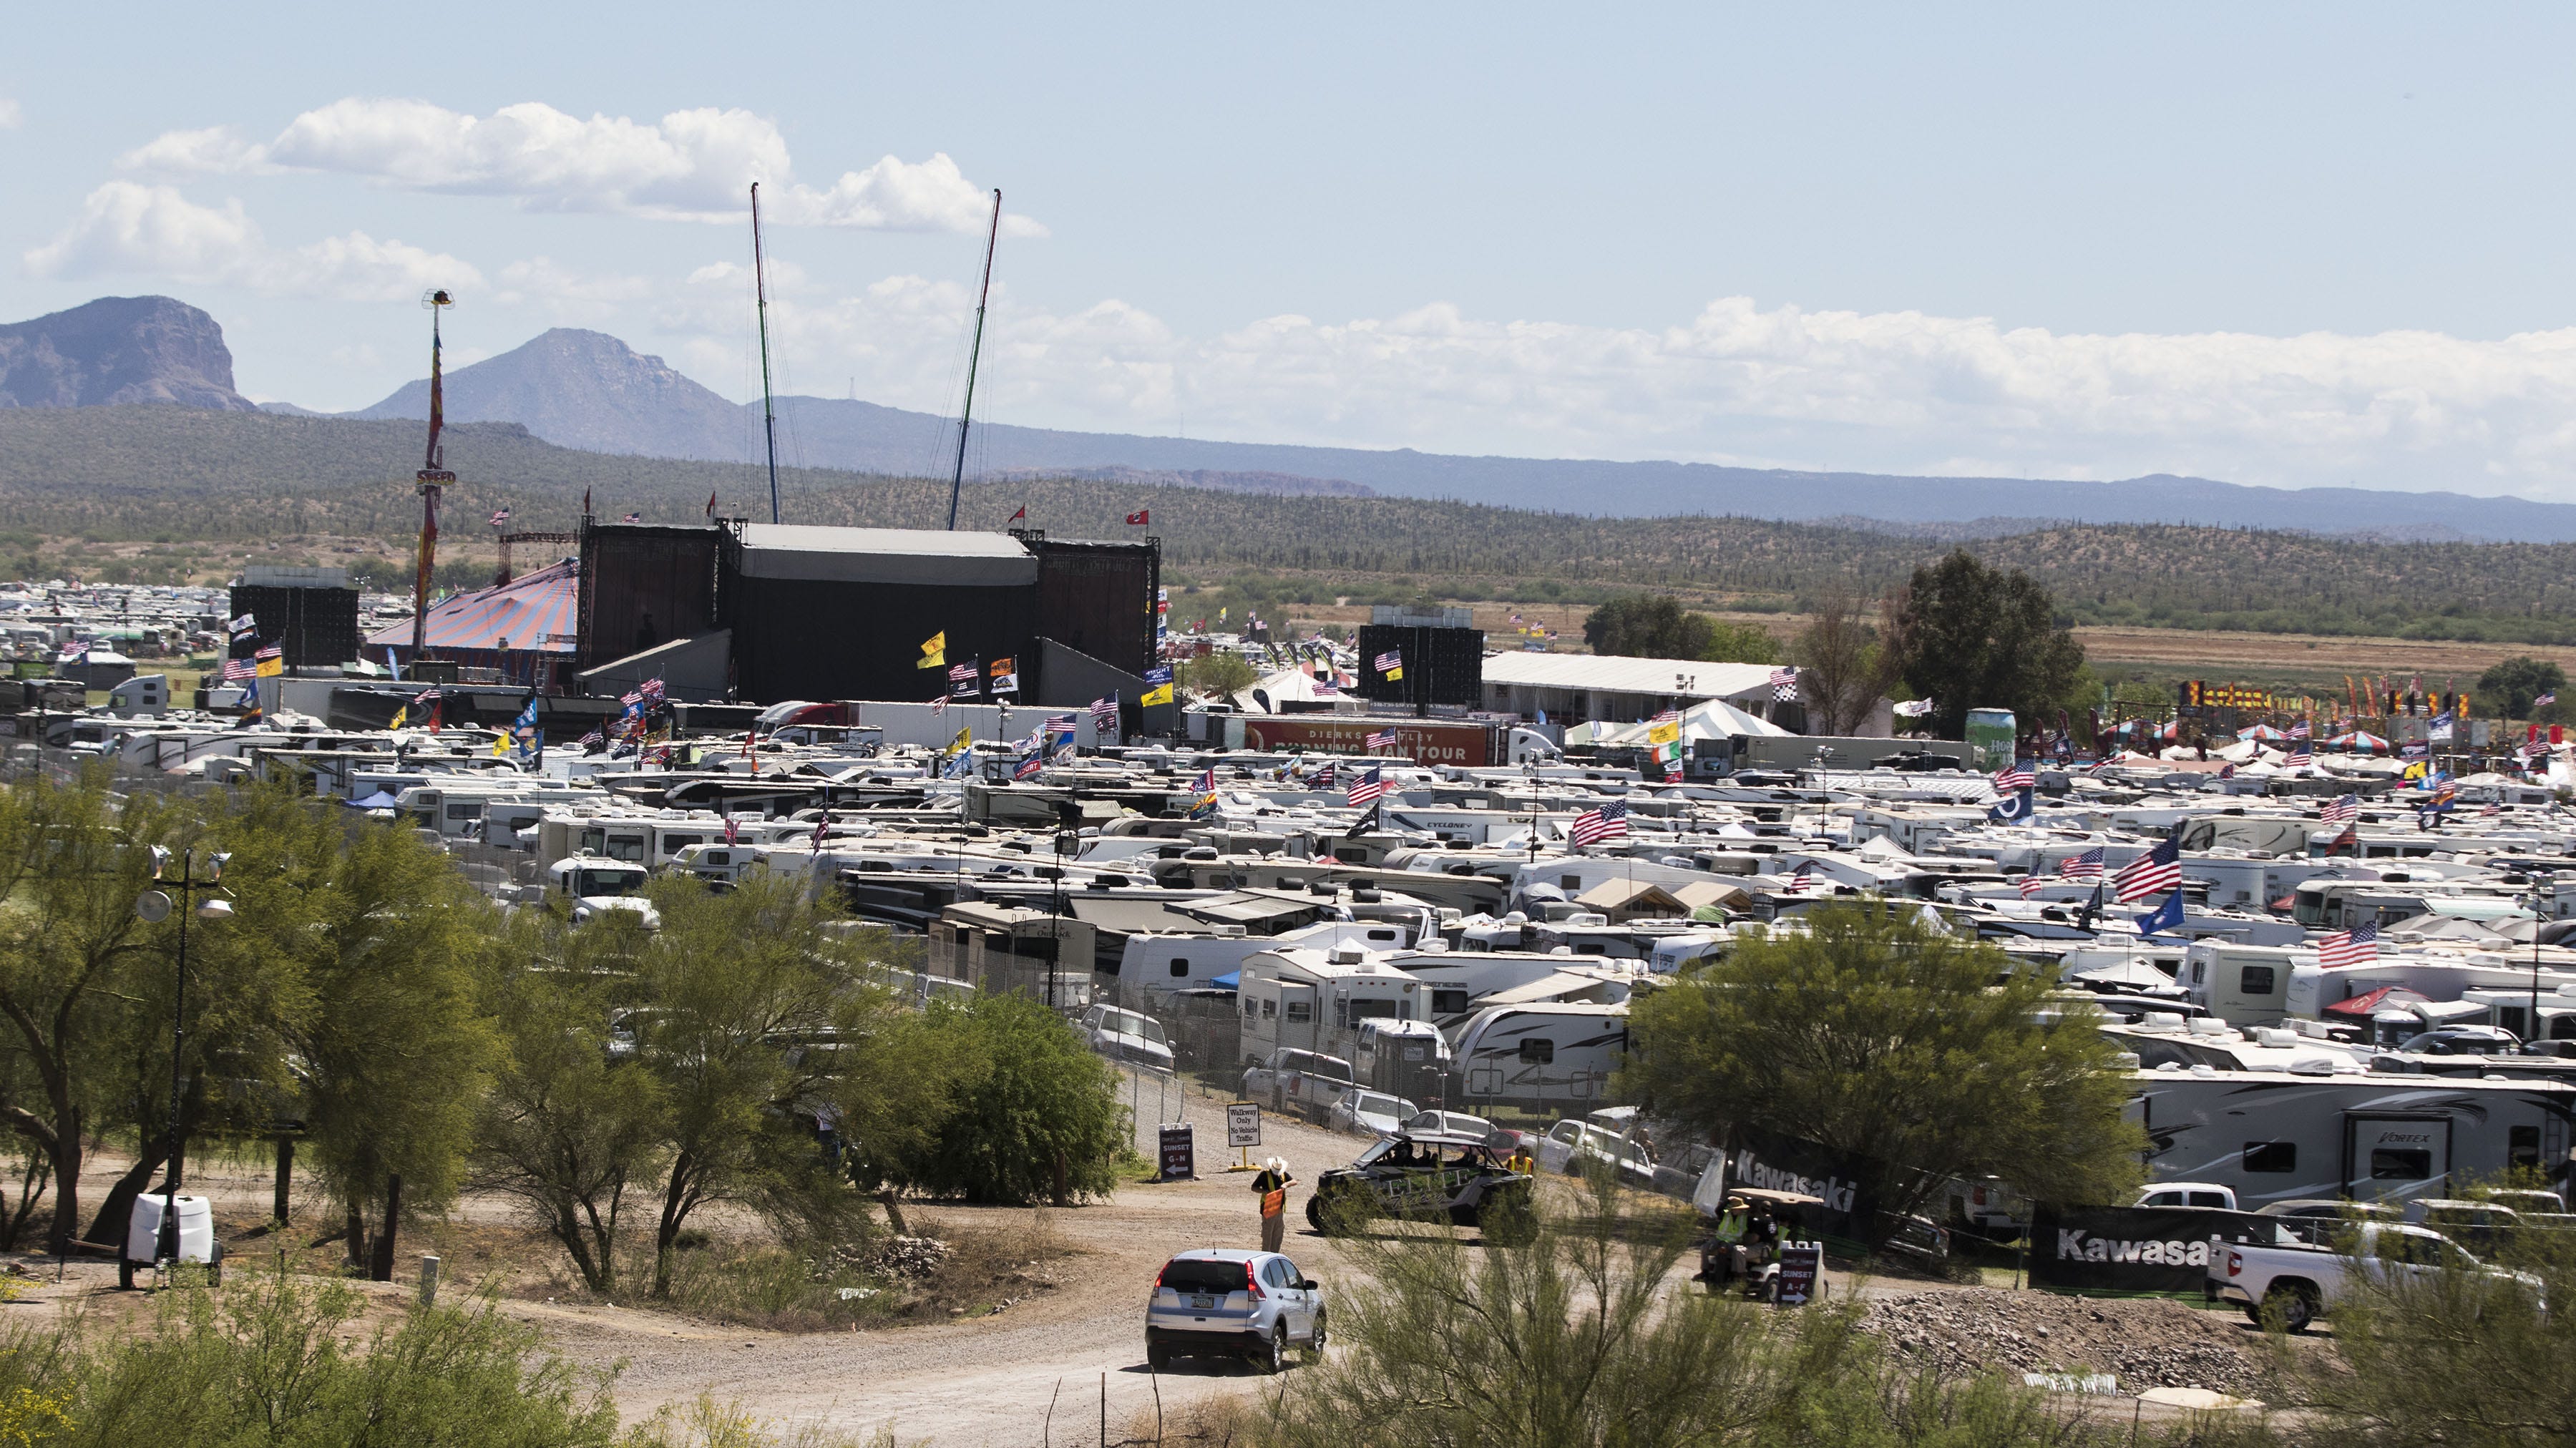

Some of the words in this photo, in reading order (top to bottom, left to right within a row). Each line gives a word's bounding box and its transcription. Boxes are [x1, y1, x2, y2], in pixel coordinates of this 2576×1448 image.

[1309, 730, 1362, 740] DIERKS
[1367, 745, 1408, 758] MAN
[1415, 745, 1466, 760] TOUR
[1037, 929, 1071, 938] Outack
[1736, 1148, 1858, 1213] Kawasaki
[2057, 1228, 2248, 1267] Kawasa
[1782, 1270, 1813, 1278] SUNSET
